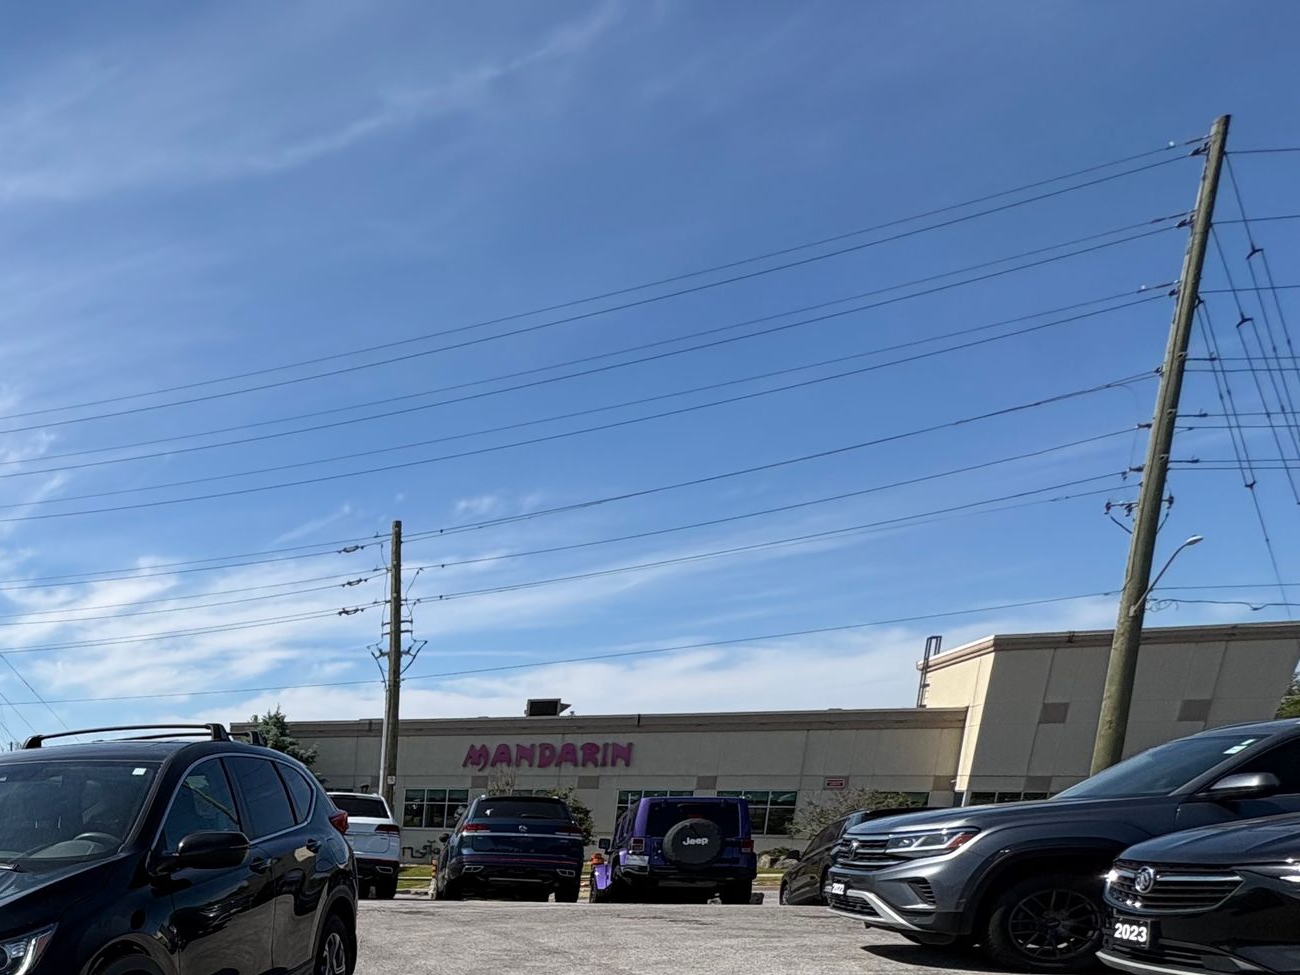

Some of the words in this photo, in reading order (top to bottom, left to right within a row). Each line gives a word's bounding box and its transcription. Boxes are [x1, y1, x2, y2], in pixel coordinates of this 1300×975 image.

[462, 742, 634, 772] MANDARIN
[682, 836, 709, 846] Jeep
[1113, 922, 1148, 943] 2023
